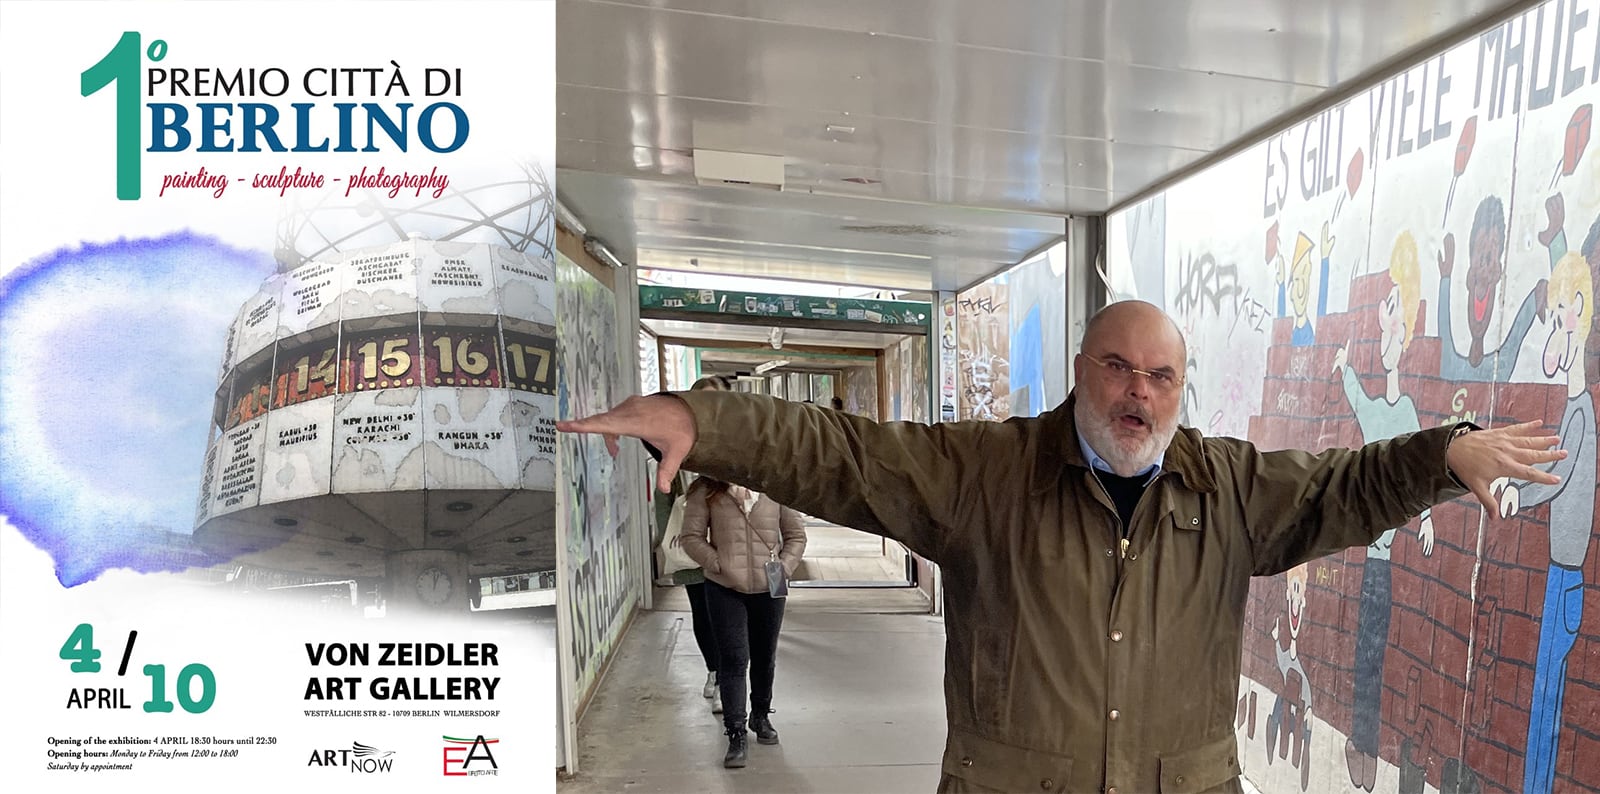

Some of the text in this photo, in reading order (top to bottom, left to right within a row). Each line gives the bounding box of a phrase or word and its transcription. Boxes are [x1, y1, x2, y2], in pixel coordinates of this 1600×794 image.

[149, 60, 462, 97] PREMIO CITTÀ DI
[1263, 0, 1600, 219] ES GILT VIELE MAUE
[146, 102, 470, 154] BERLINO
[159, 167, 228, 198] painting
[252, 166, 324, 198] sculpture
[345, 166, 449, 198] photography
[358, 339, 412, 380] 15
[432, 336, 490, 375] 16
[506, 343, 551, 384] 17
[294, 348, 337, 394] 14
[343, 417, 362, 425] NEW
[367, 415, 393, 423] DELHI
[357, 425, 400, 433] KARACHI
[438, 432, 479, 440] RANGUN
[305, 643, 499, 667] VON ZEIDLER
[59, 624, 102, 673] 4
[143, 663, 217, 713] 10
[67, 688, 131, 709] APRIL
[304, 677, 501, 700] ART GALLERY
[47, 736, 277, 747] Opening of the exhibition: 4 APRIL 18:30 hours until 22:30
[47, 749, 239, 760] Opening hours: Monday to Friday from 12:00 to 18:00
[308, 749, 393, 773] ART NOW
[47, 762, 133, 773] Saturday by appointment
